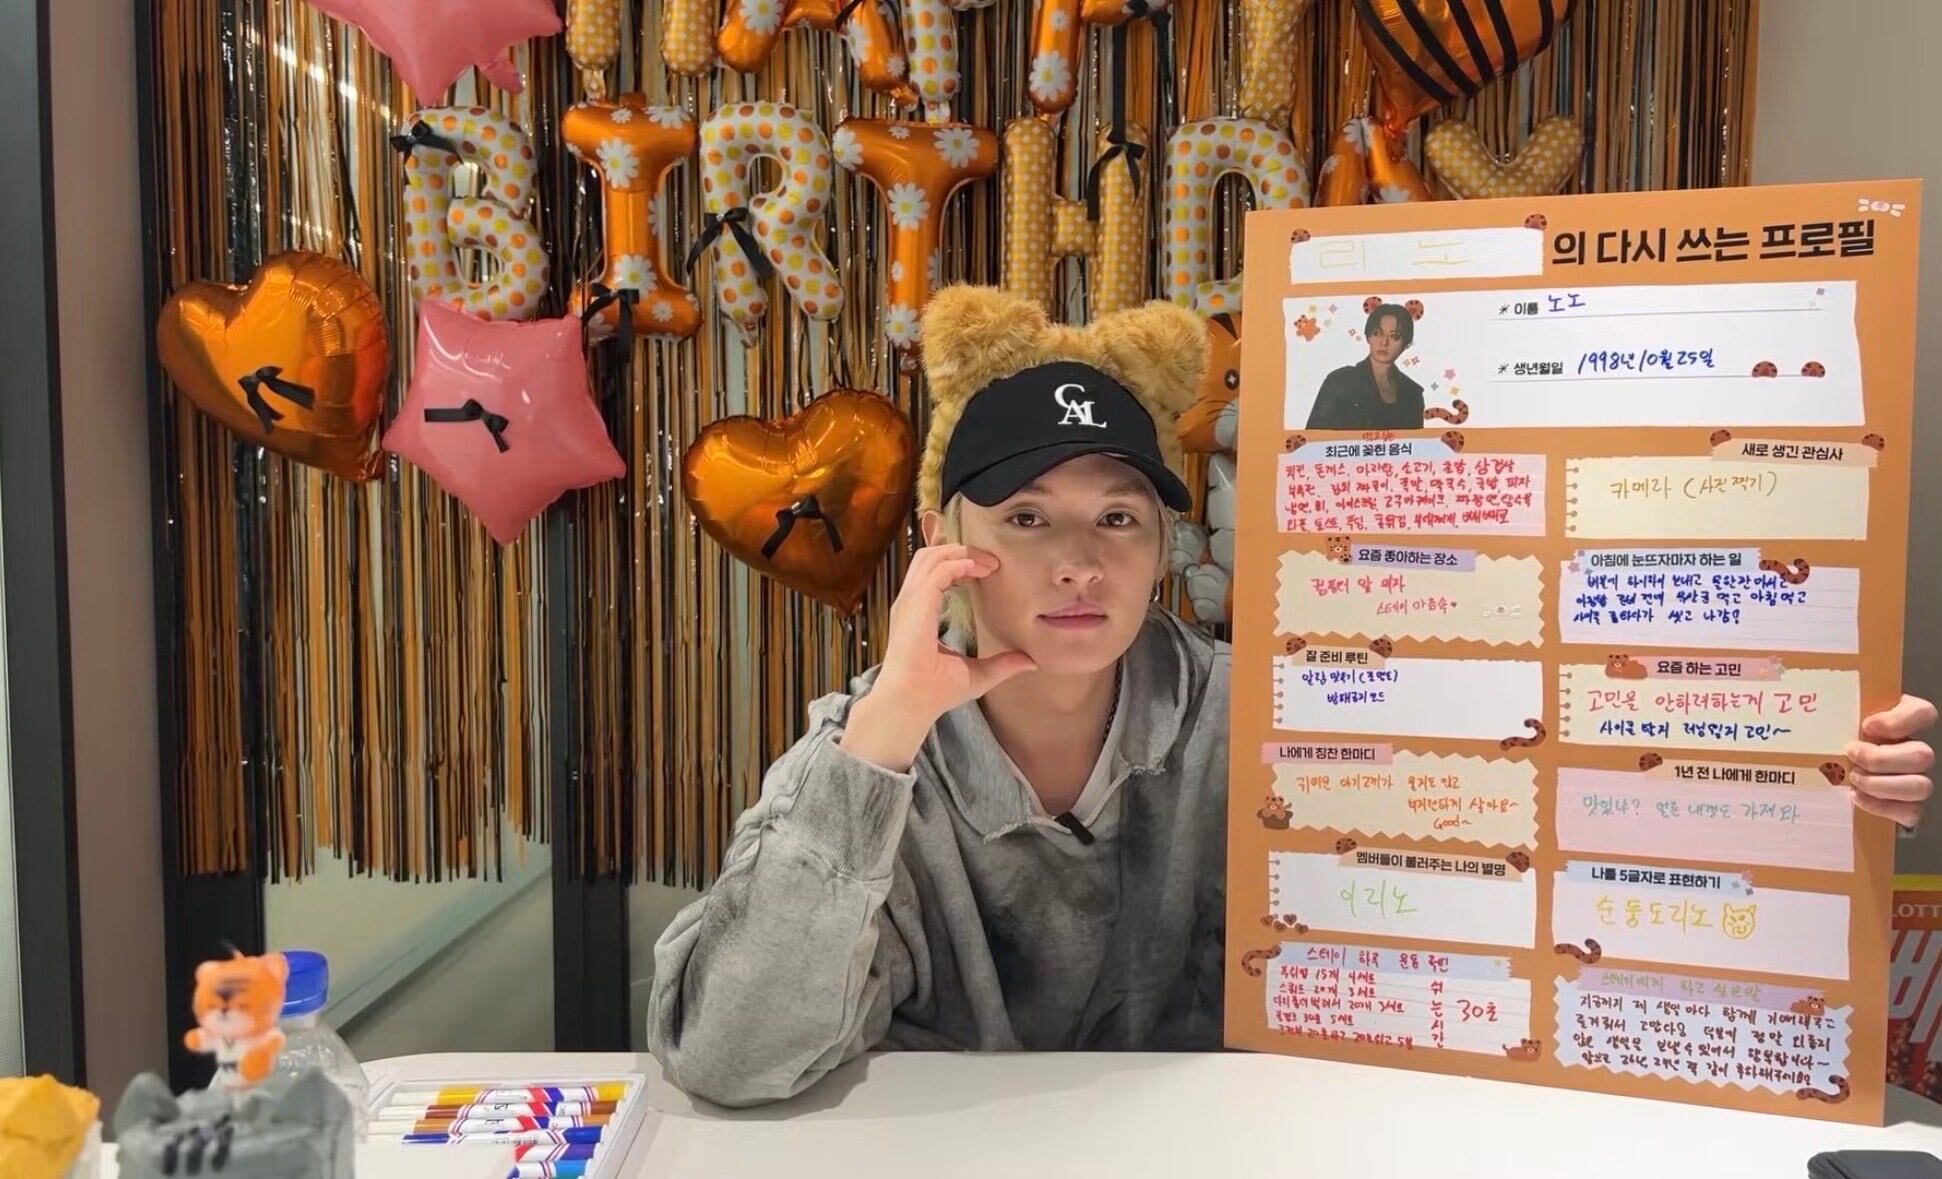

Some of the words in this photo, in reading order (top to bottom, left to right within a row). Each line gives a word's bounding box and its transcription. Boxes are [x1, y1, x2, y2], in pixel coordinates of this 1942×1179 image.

[1552, 231, 1585, 265] 의
[1596, 228, 1666, 264] 다시
[1676, 227, 1750, 262] 쓰는
[1759, 219, 1875, 260] 프로필
[1514, 302, 1539, 315] 이름
[1514, 361, 1563, 375] 생년월일
[1325, 445, 1360, 458] 최근에
[1362, 444, 1386, 457] 꽂힌
[1388, 442, 1412, 457] 음식
[1742, 442, 1769, 457] 새로
[1772, 444, 1799, 459] 생긴
[1801, 445, 1843, 461] 관심사
[1609, 476, 1672, 500] 카메라
[1358, 549, 1382, 562] 요즘
[1383, 549, 1431, 565] 좋아하는
[1434, 552, 1458, 566] 장소
[1591, 553, 1629, 567] 아침에
[1631, 553, 1697, 567] 눈뜨자마자
[1699, 553, 1725, 567] 하는
[1728, 552, 1742, 566] 일
[1311, 577, 1350, 596] 컴퓨터
[1306, 650, 1317, 662] 잘
[1320, 650, 1342, 663] 준비
[1345, 652, 1368, 664] 루틴
[1656, 661, 1683, 675] 요즘
[1685, 662, 1712, 676] 하는
[1714, 663, 1742, 677] 고민
[1587, 690, 1640, 713] 고민을
[1772, 691, 1819, 713] 고민
[1279, 746, 1313, 759] 나에게
[1315, 747, 1339, 760] 칭찬
[1340, 747, 1376, 761] 한마디
[1674, 765, 1694, 779] 1년
[1696, 766, 1710, 780] 전
[1712, 767, 1751, 782] 나에게
[1755, 768, 1795, 785] 한마디
[1356, 851, 1403, 868] 멤버들이
[1405, 853, 1452, 872] 불러주는
[1455, 860, 1478, 874] 나의
[1482, 862, 1506, 876] 별명
[1591, 867, 1616, 881] 나를
[1619, 869, 1665, 885] 5글자로
[1668, 873, 1721, 889] 표현하기
[1892, 903, 1942, 918] OTT
[1306, 947, 1346, 968] 스테이
[1579, 993, 1623, 1012] 지금까지
